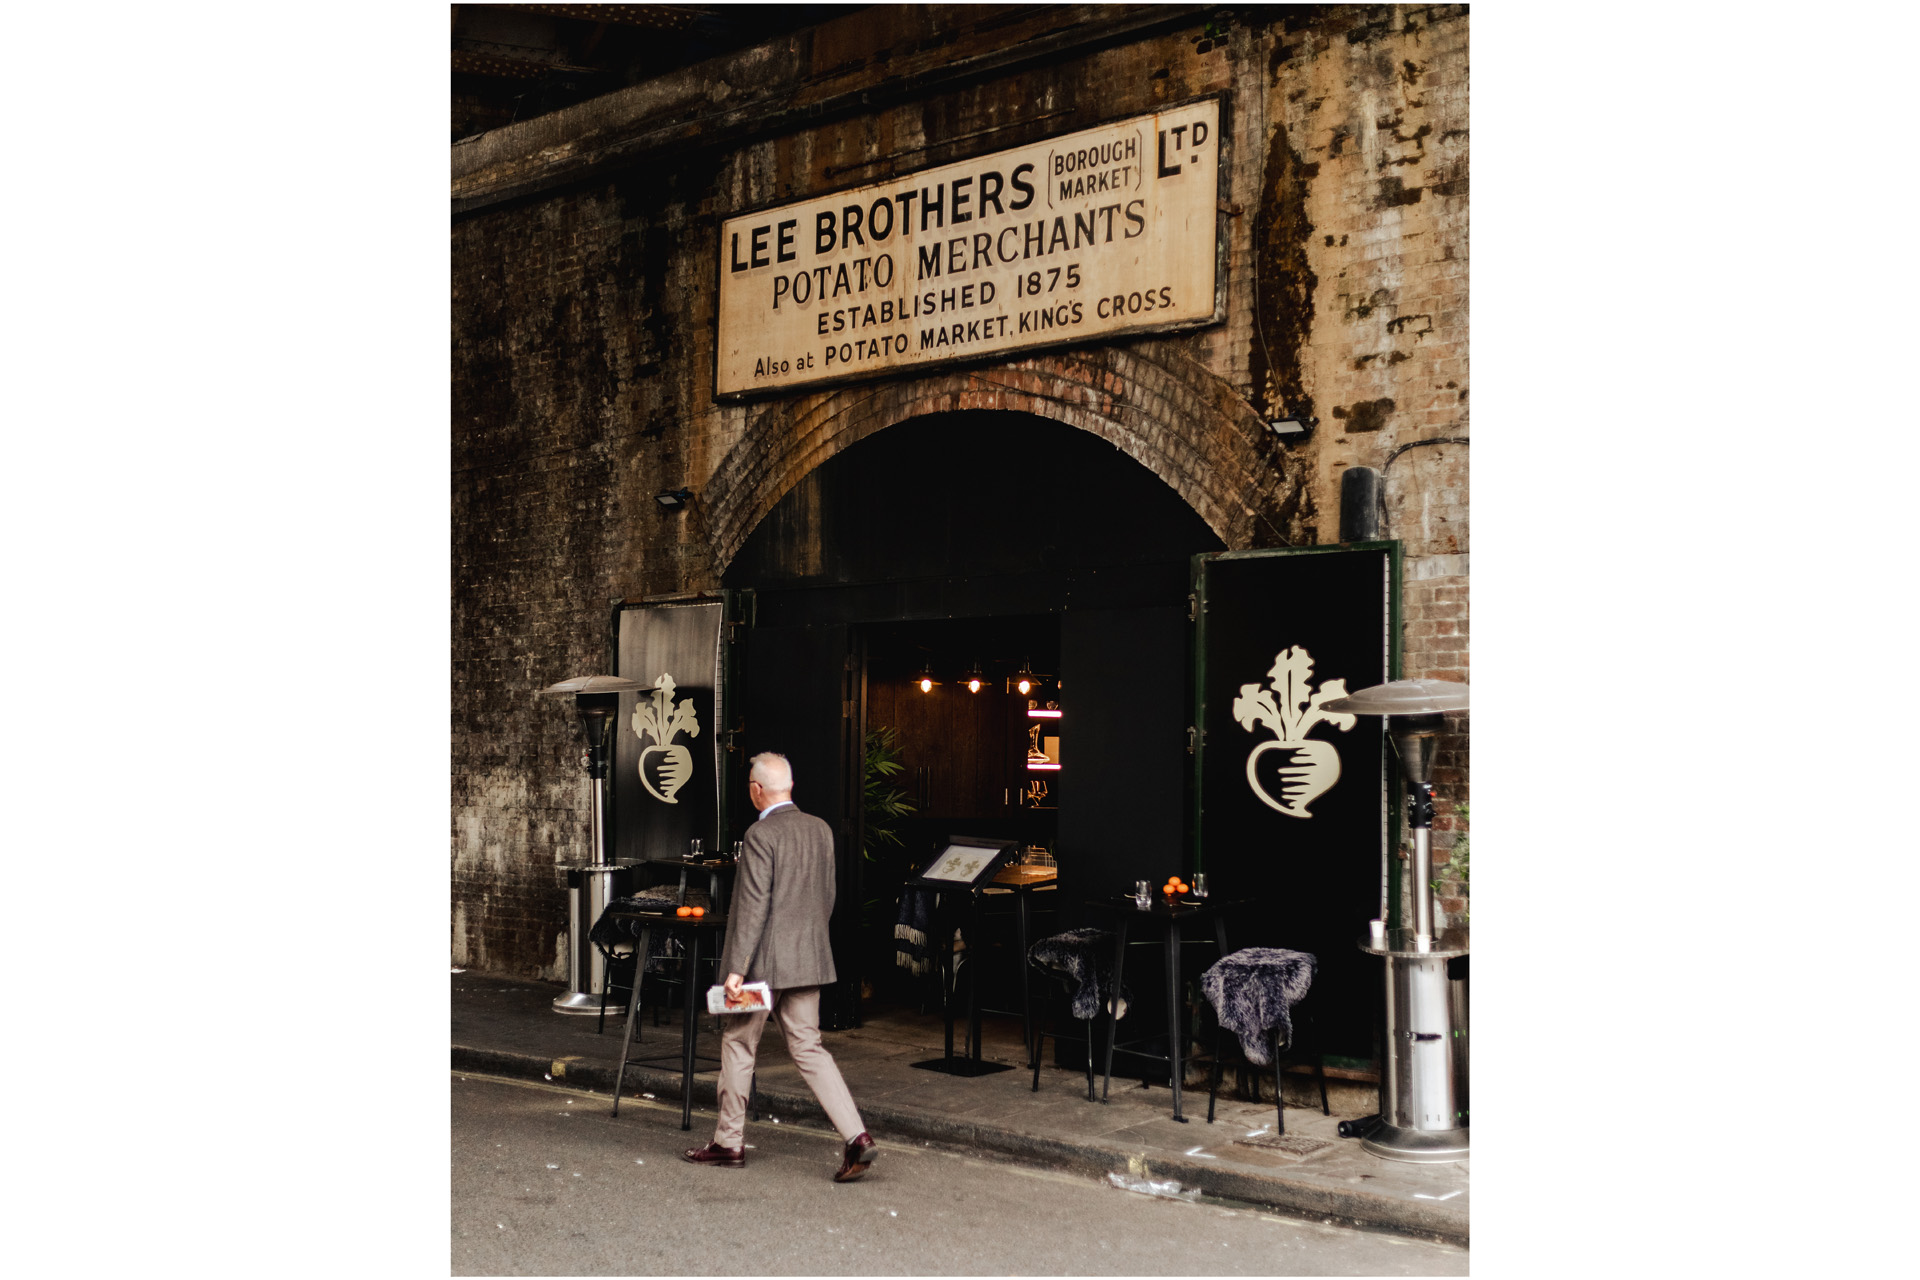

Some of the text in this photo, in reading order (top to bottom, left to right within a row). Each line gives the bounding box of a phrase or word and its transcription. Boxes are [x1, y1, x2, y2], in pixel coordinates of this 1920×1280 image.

[731, 218, 797, 273] LEE
[815, 162, 1035, 255] BROTHERS
[772, 199, 1145, 309] POTATO MERCHANTS
[754, 355, 790, 377] Also
[796, 351, 814, 370] at
[825, 332, 909, 365] POTATO
[1096, 286, 1176, 319] CROSS.
[818, 263, 1081, 335] ESTABLISHED 1875
